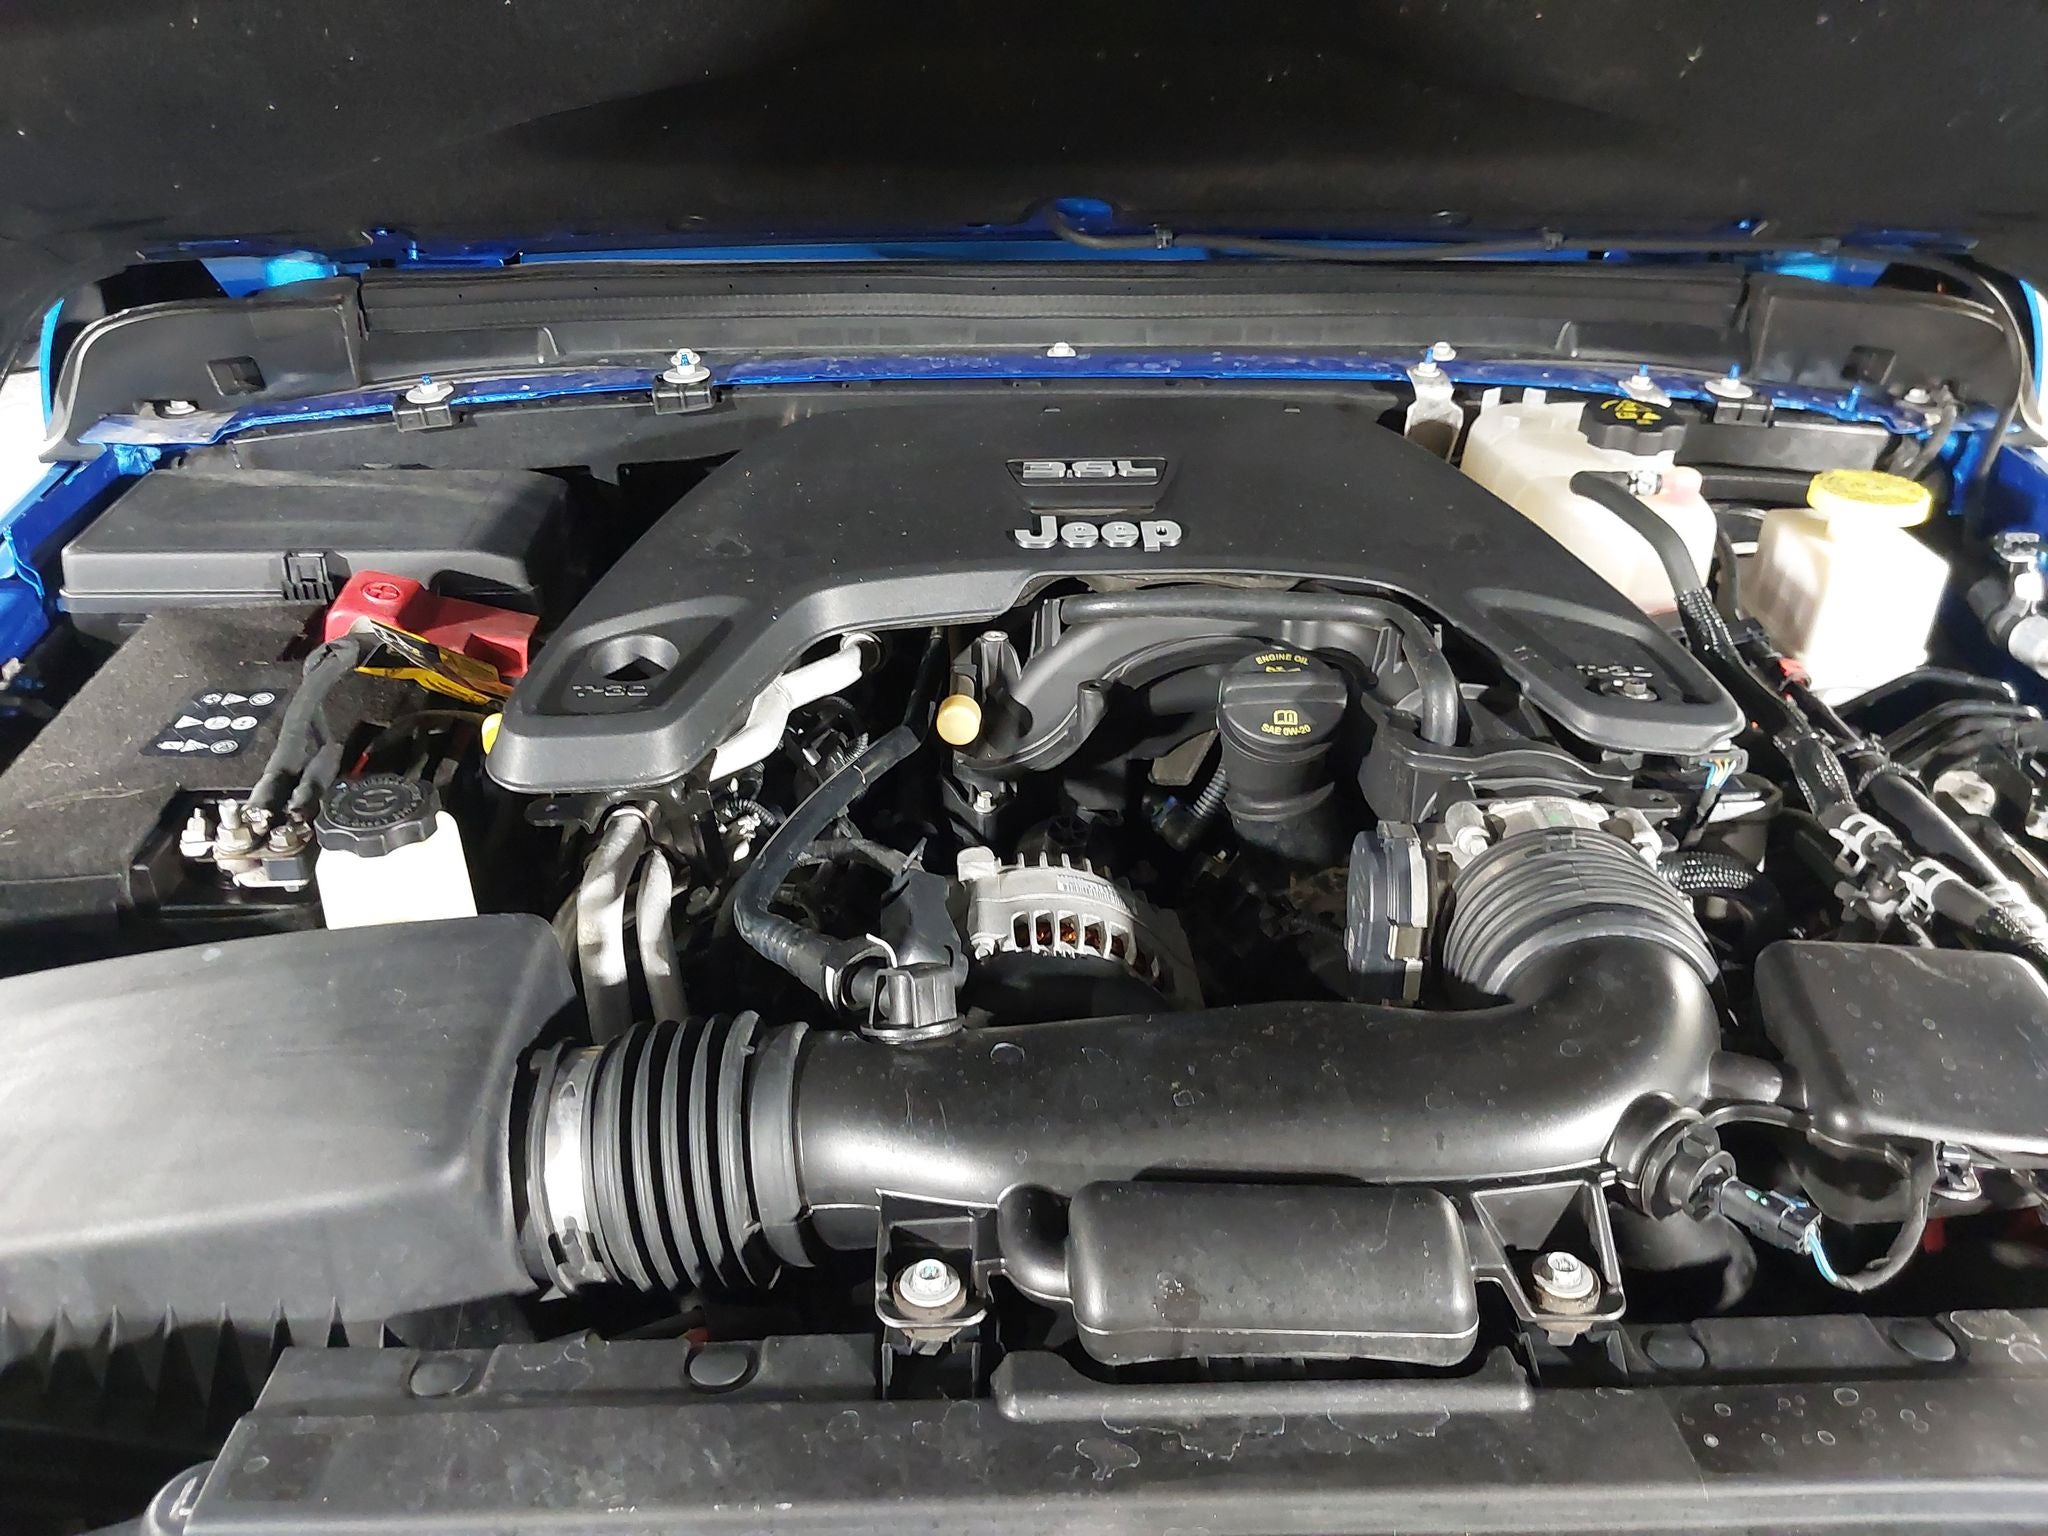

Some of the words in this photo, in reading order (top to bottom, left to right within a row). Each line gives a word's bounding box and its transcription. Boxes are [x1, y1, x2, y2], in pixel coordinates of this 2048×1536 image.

[1022, 460, 1158, 479] 3.6L
[1014, 515, 1183, 552] Jeep
[1255, 653, 1293, 665] ENGINE
[1294, 655, 1310, 666] OIL
[1261, 723, 1282, 736] SAE
[1283, 724, 1312, 736] 0W-20
